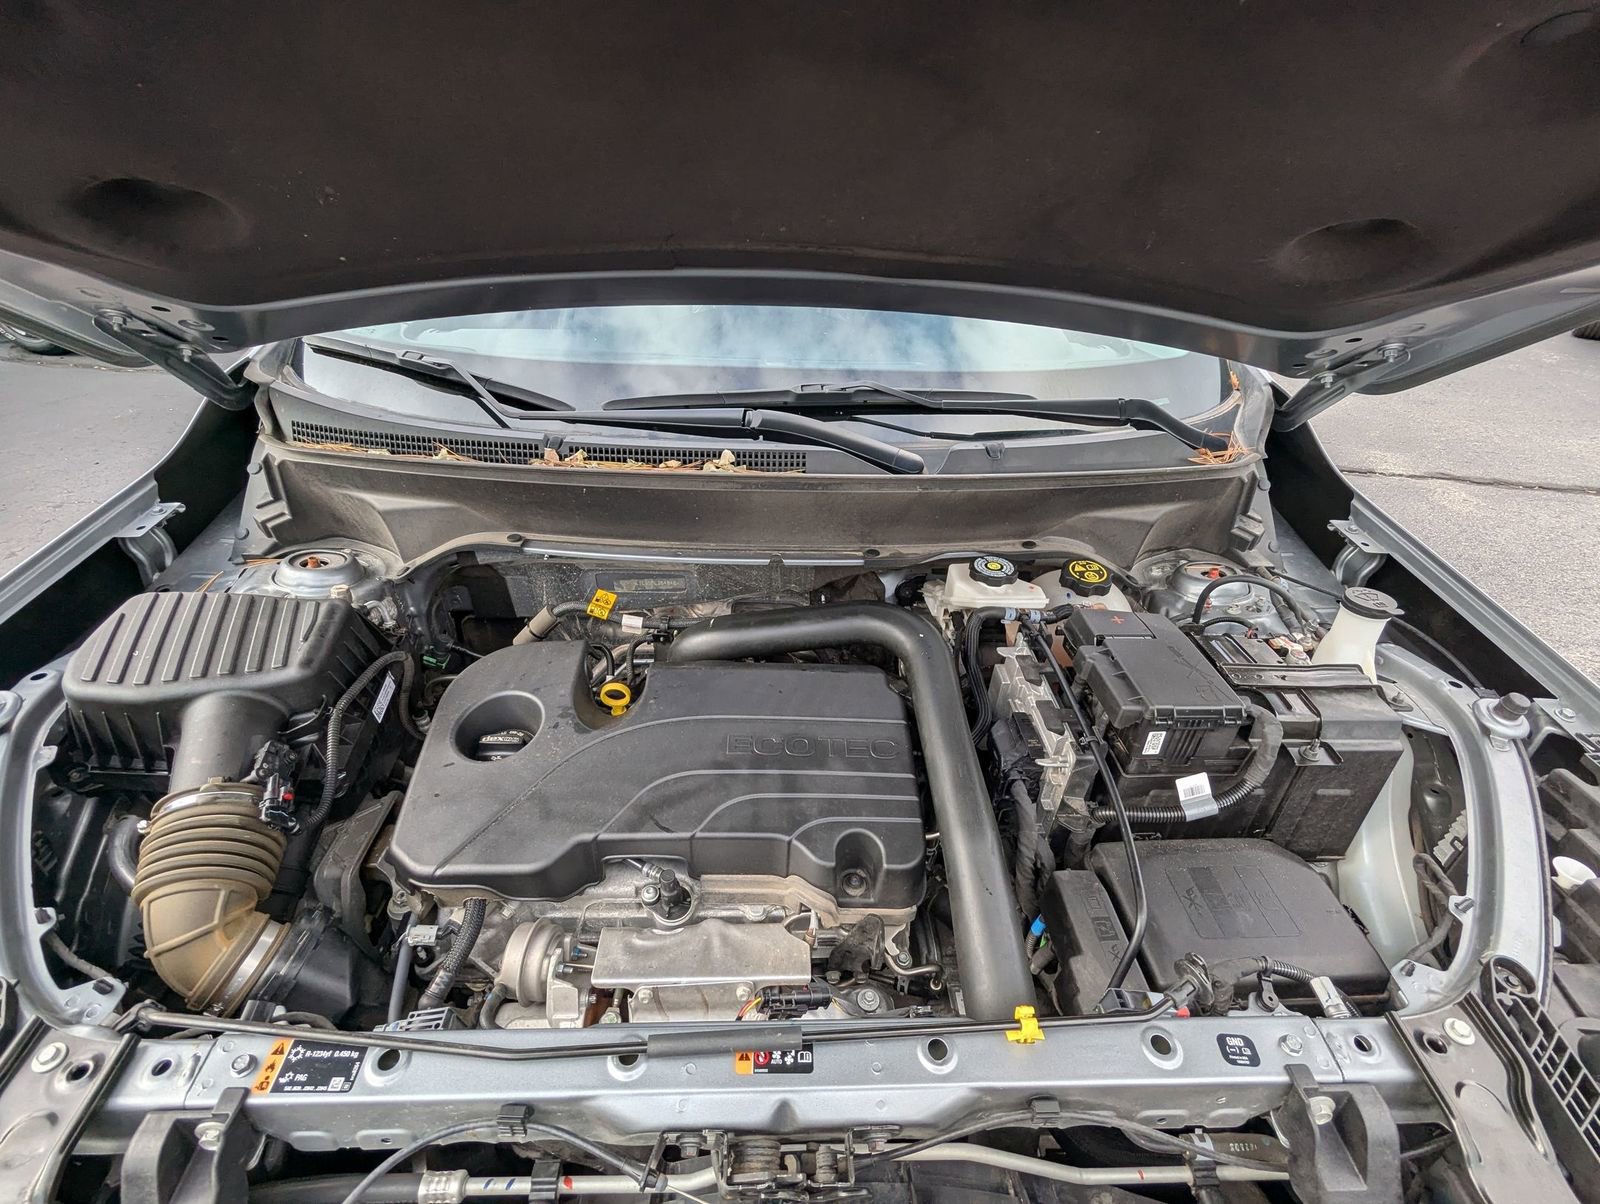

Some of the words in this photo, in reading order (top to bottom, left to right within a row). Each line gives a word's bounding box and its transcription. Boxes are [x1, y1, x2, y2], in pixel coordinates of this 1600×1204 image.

[726, 734, 900, 760] ECOTEC
[1226, 1036, 1244, 1046] GND
[304, 1050, 332, 1059] R-1234yf
[350, 1051, 360, 1059] kg
[294, 1073, 309, 1082] PAG
